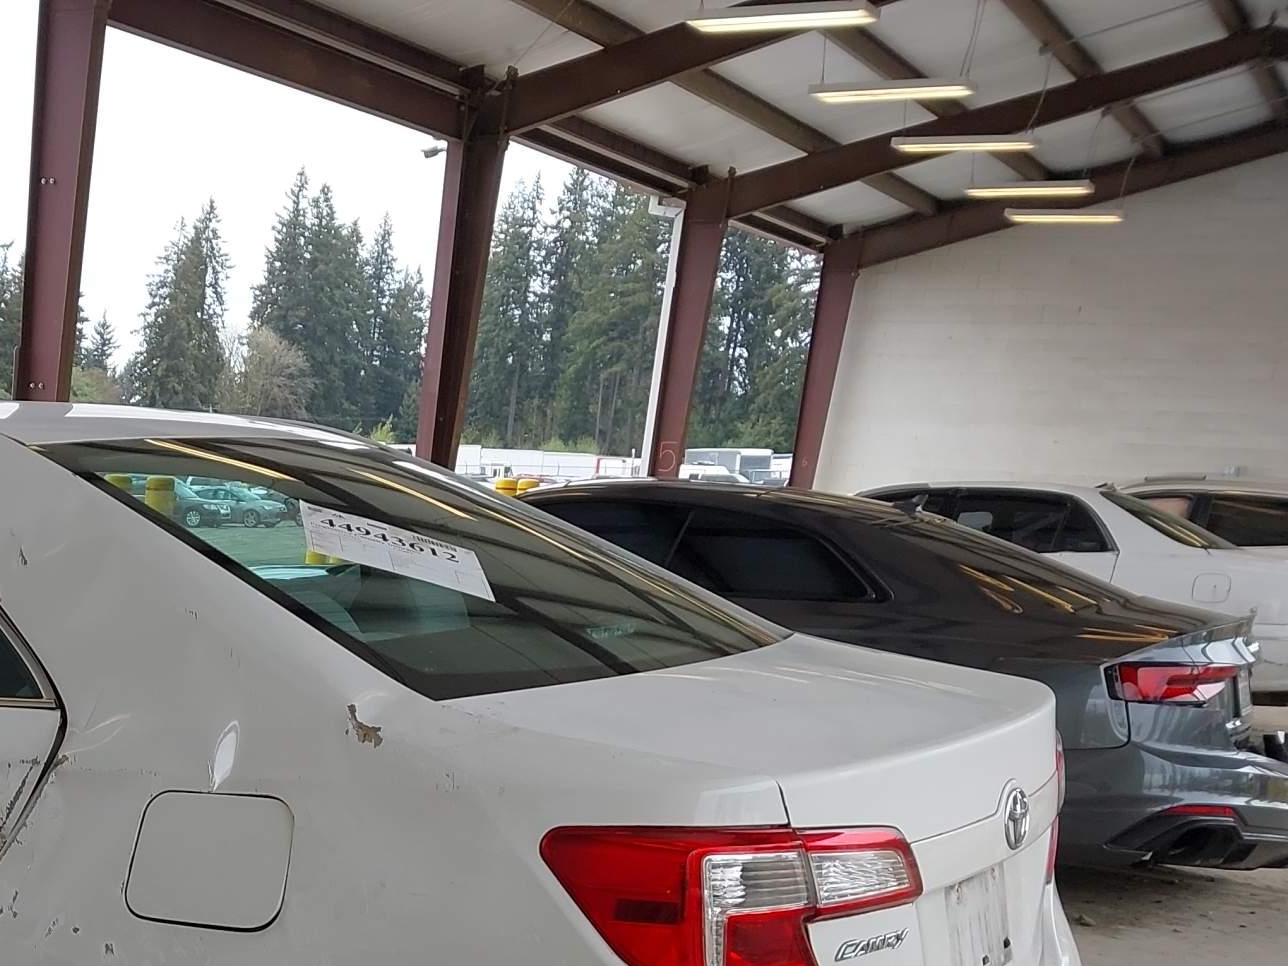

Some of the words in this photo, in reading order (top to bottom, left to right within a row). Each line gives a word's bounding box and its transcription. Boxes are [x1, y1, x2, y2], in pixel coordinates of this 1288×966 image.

[658, 441, 680, 472] 5
[320, 518, 460, 563] 44943612
[834, 927, 909, 962] CAMRY
